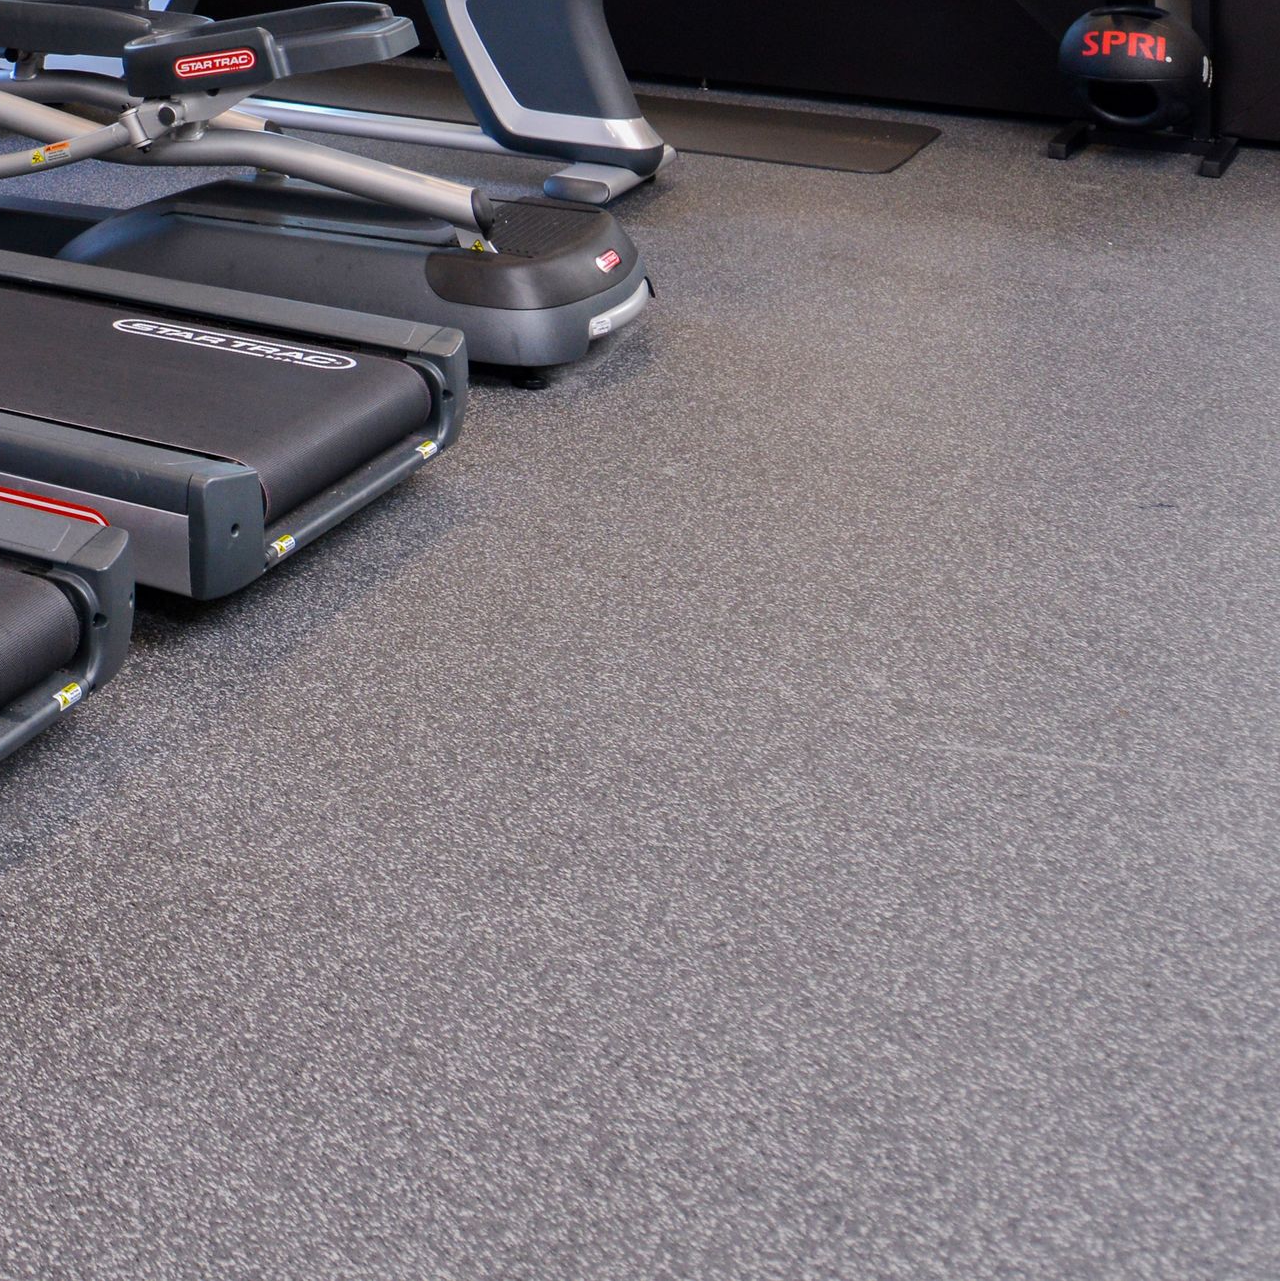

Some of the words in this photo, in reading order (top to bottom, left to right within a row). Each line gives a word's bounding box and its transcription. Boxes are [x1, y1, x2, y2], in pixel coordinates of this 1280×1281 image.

[1082, 31, 1166, 62] SPRI
[180, 60, 213, 72] STAR
[213, 55, 248, 67] TRAC
[129, 322, 226, 345] STAR
[231, 340, 337, 365] TRAC
